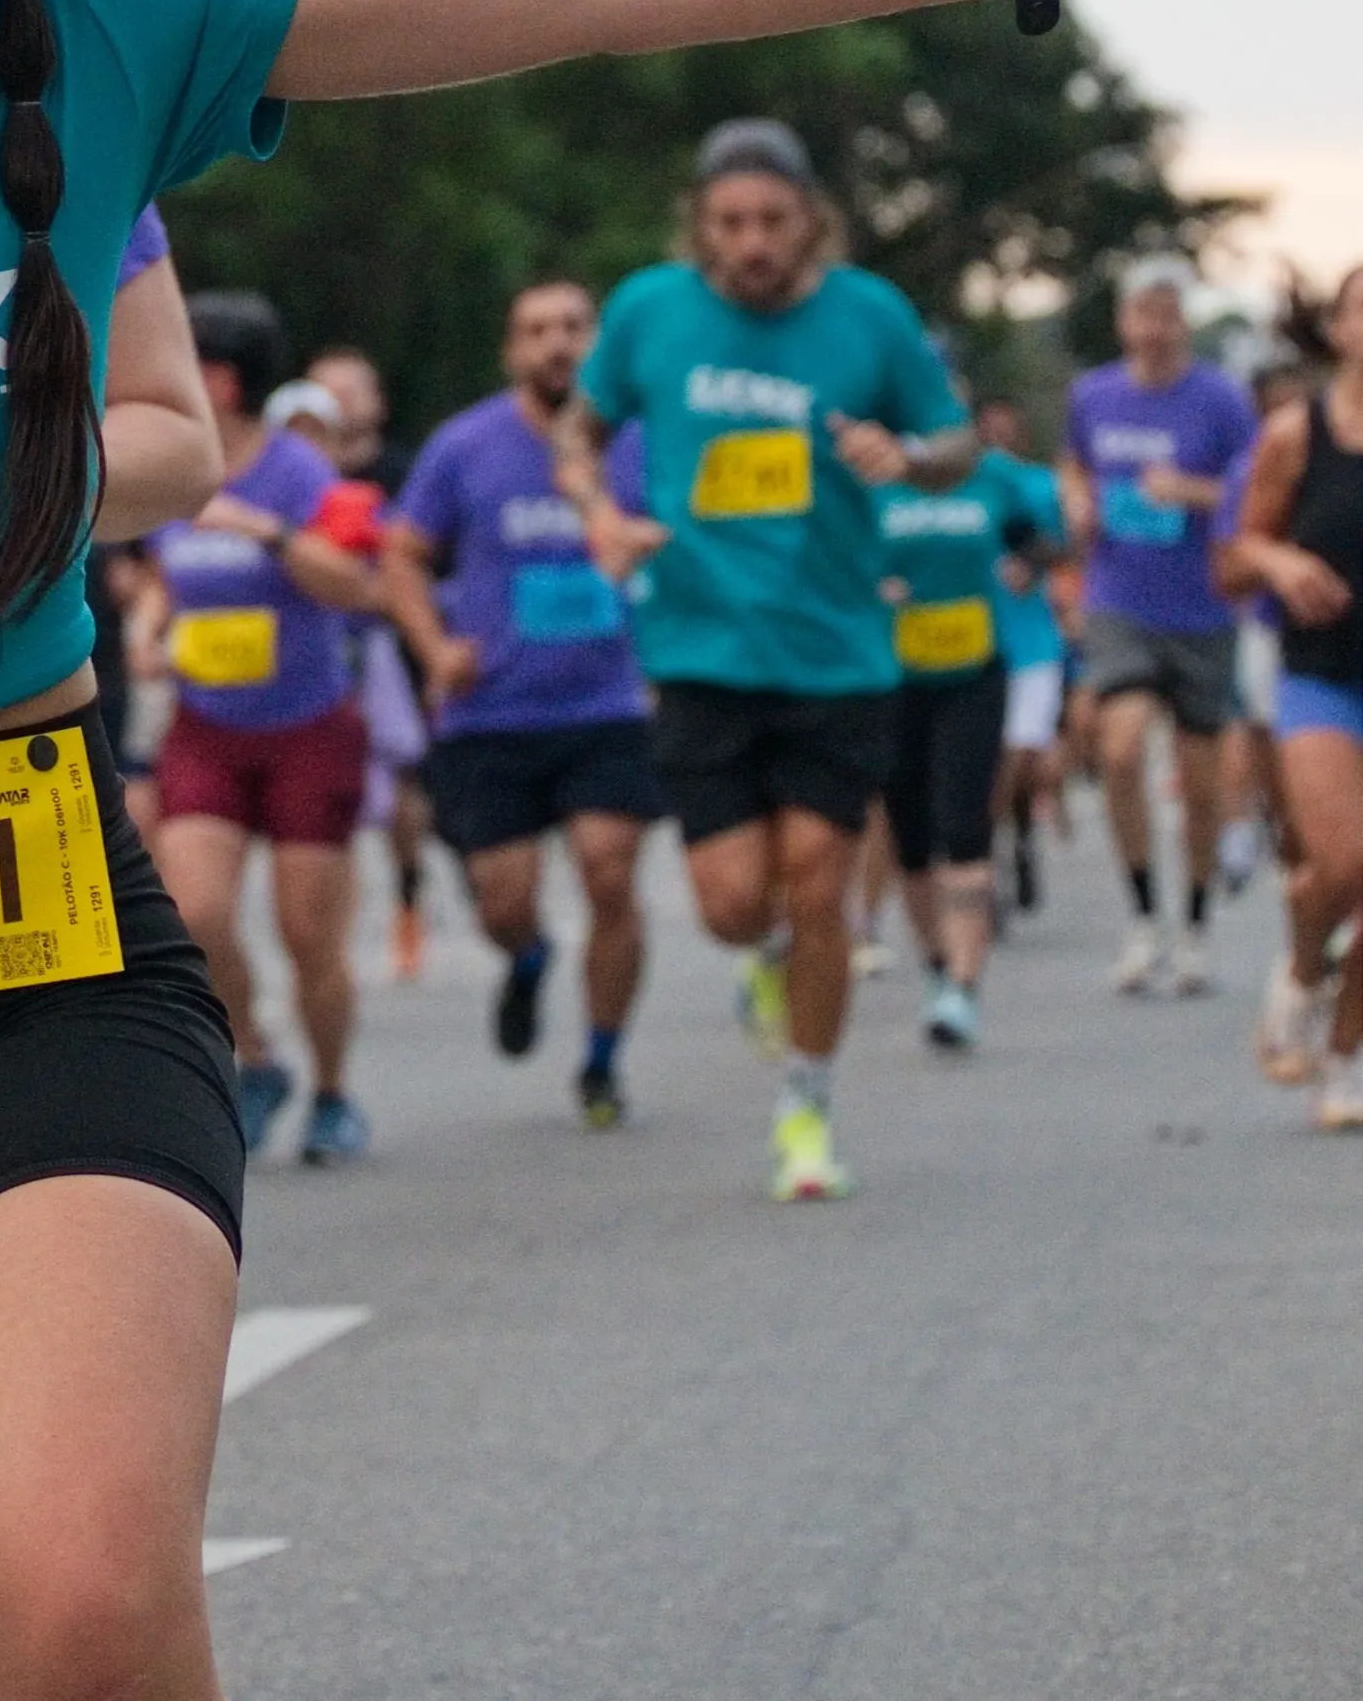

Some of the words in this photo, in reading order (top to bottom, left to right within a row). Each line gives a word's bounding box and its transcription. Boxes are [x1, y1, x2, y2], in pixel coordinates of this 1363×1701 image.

[68, 762, 83, 792] 1291
[50, 787, 66, 827] 06H00
[58, 830, 68, 850] 10K
[62, 860, 70, 869] C
[63, 871, 78, 925] PELOTÃO
[89, 884, 104, 913] 1291
